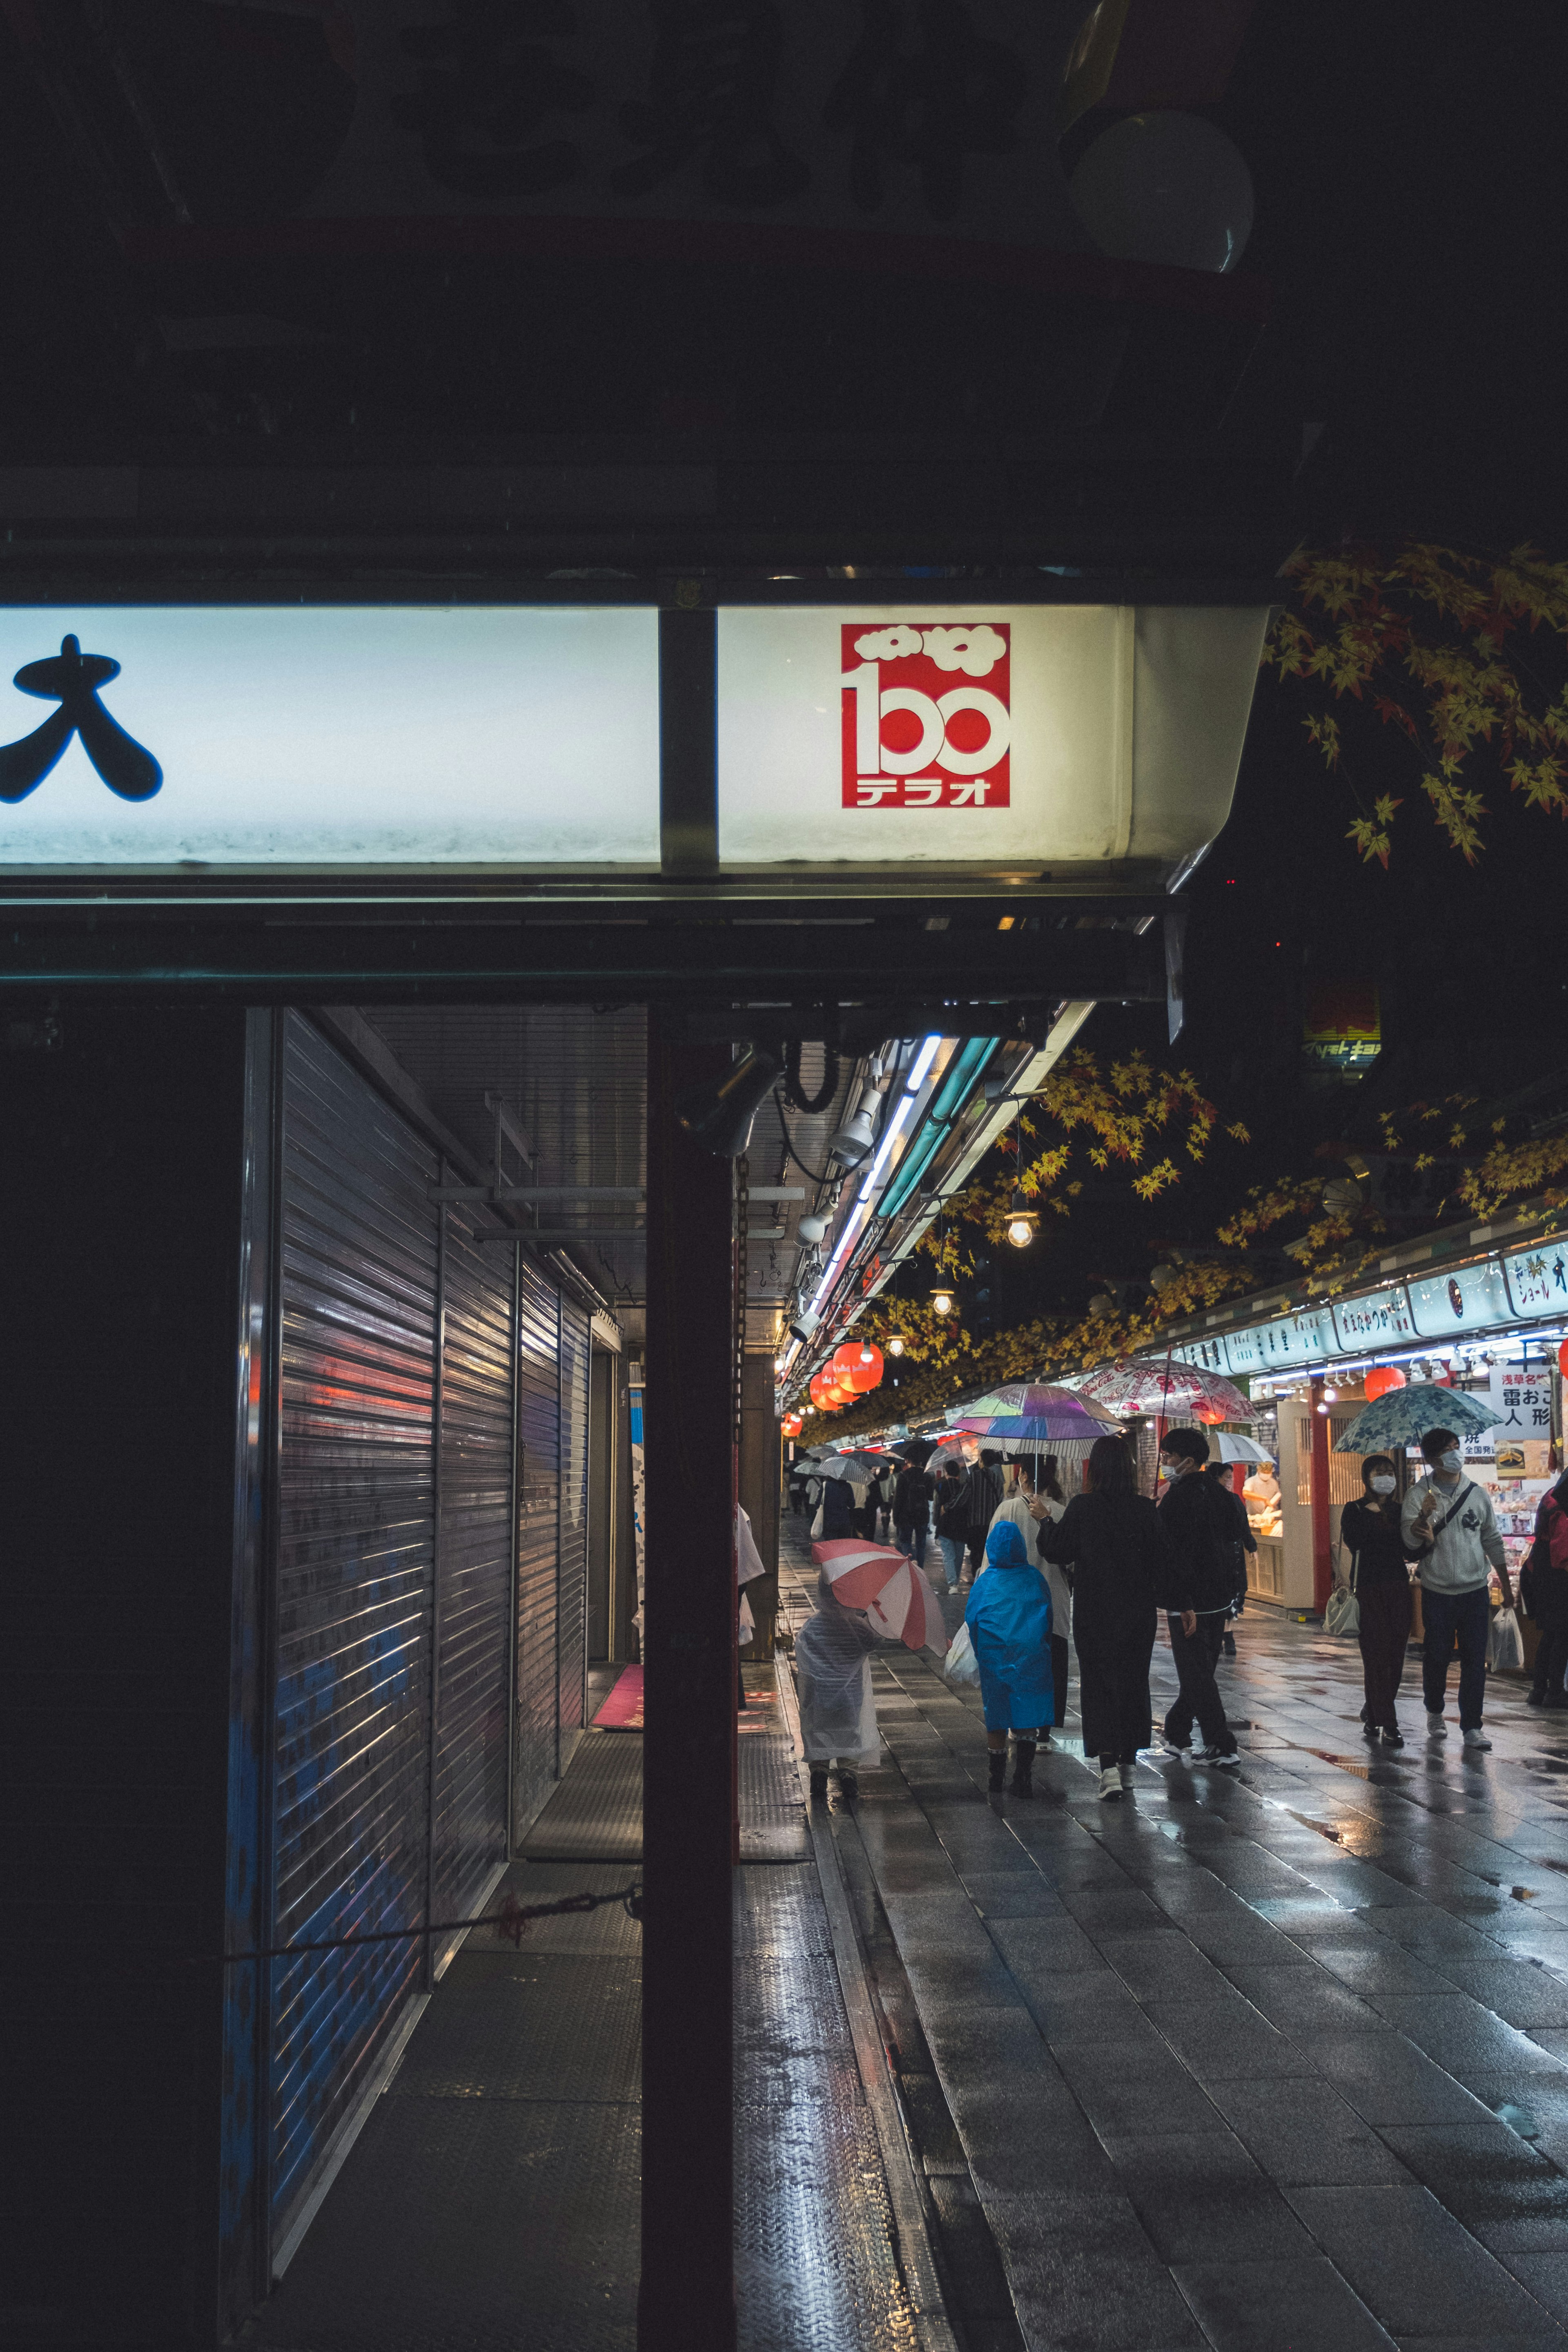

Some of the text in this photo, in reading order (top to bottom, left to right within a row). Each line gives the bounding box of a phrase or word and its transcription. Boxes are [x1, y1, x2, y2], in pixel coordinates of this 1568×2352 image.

[0, 633, 164, 804] 大
[842, 662, 1011, 775] 100
[856, 778, 991, 806] テラオ
[1519, 1279, 1549, 1304] ショール
[1505, 1408, 1550, 1426] 人形
